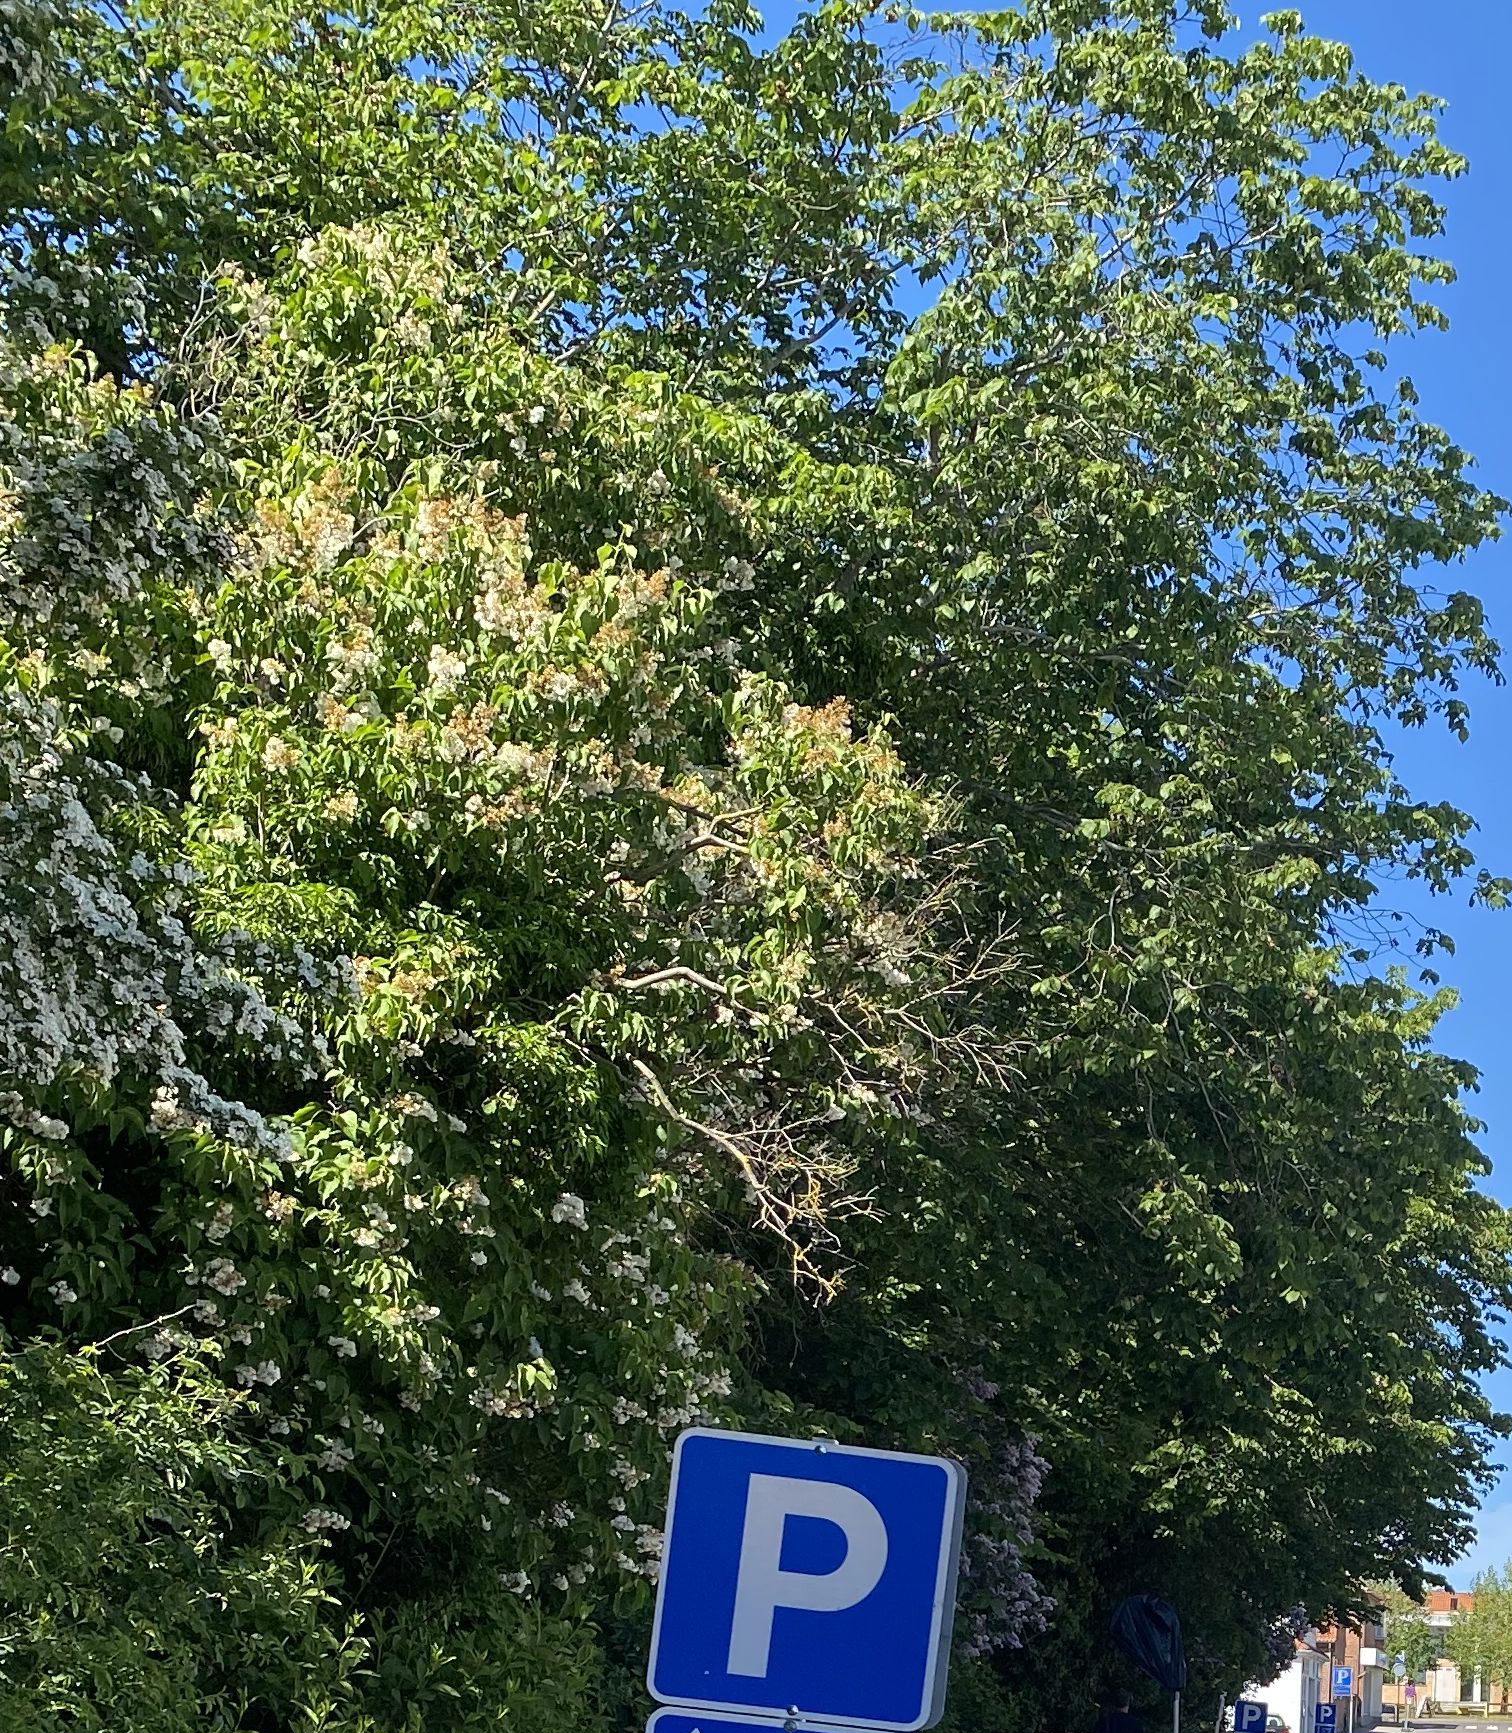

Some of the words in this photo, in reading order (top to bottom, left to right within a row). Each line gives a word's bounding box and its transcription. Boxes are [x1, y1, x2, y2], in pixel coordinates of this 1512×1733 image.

[727, 1473, 888, 1678] P
[1336, 1669, 1349, 1684] P
[1242, 1704, 1262, 1730] P
[1320, 1705, 1333, 1723] P
